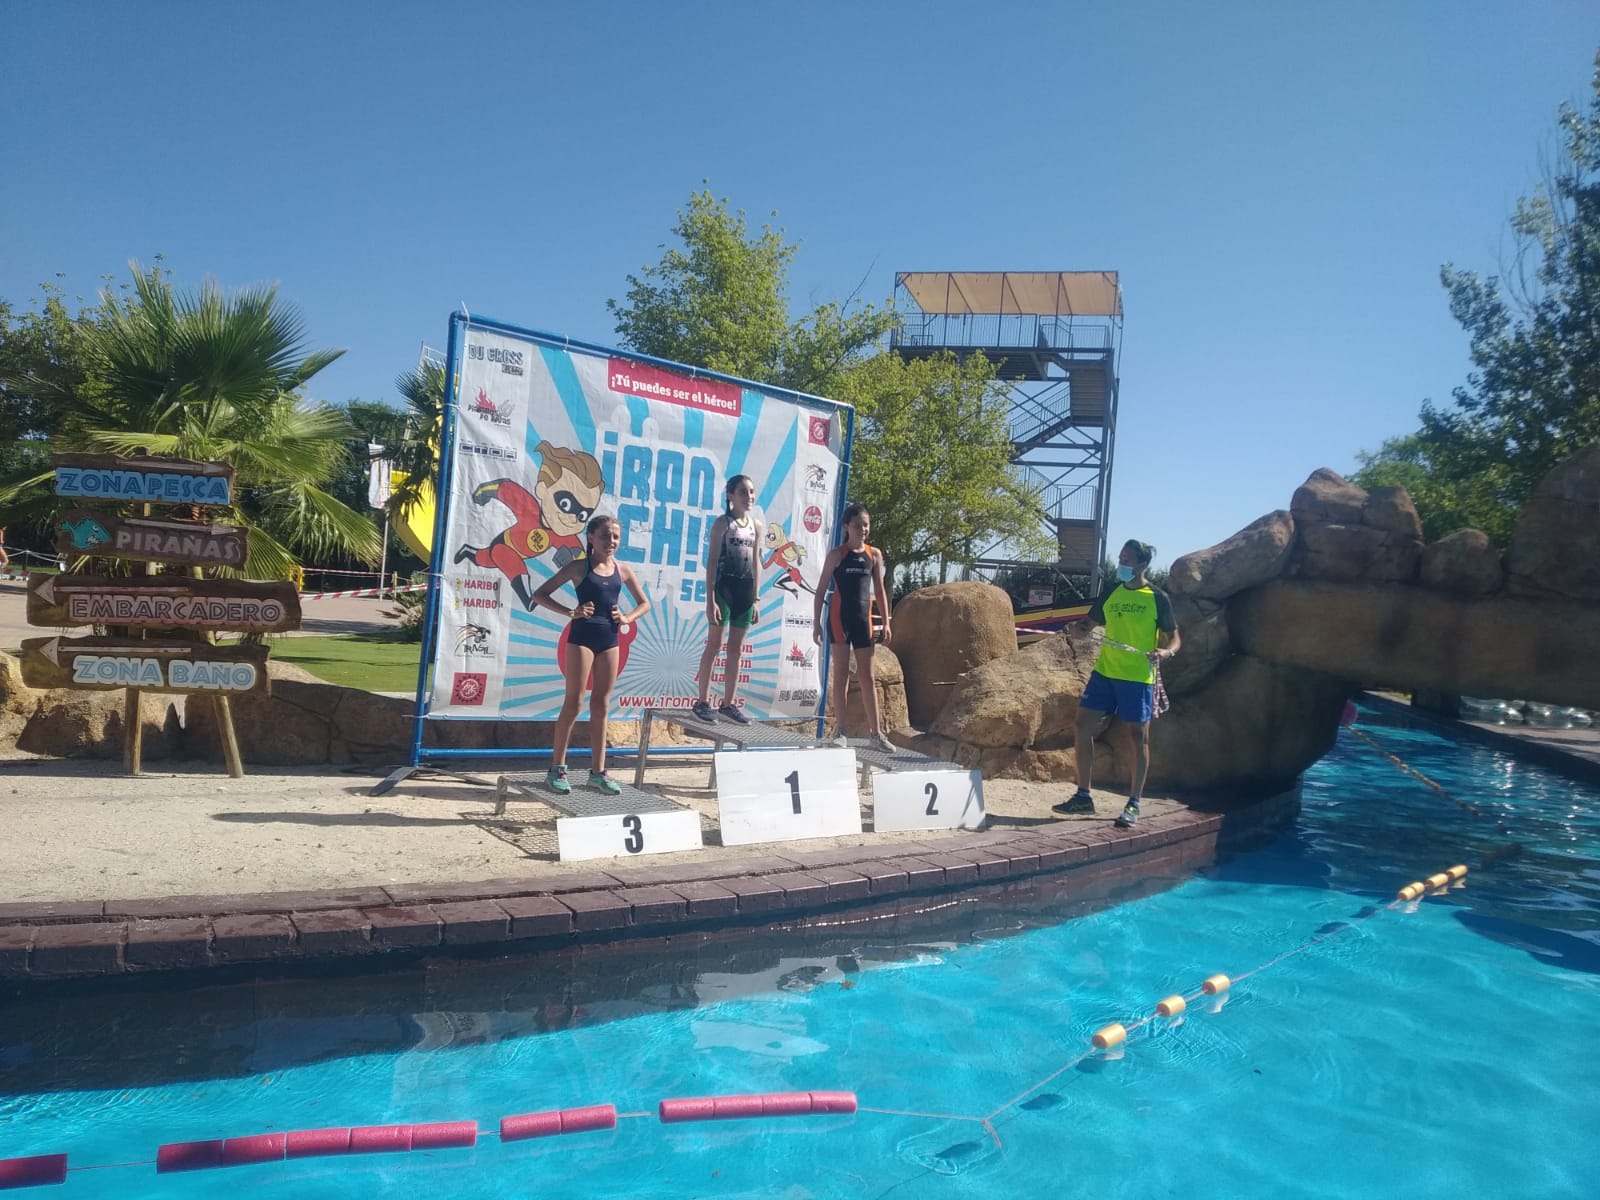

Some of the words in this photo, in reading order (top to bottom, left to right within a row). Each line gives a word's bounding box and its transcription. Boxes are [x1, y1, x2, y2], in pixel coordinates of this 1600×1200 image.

[487, 348, 524, 366] CROSS
[611, 373, 631, 388] ¡Tú
[632, 380, 671, 397] puedes
[673, 389, 690, 400] ser
[691, 391, 702, 403] el
[704, 393, 737, 410] héroe!
[59, 471, 143, 496] ZONA
[146, 476, 227, 500] PESCA
[115, 530, 239, 560] PIRAÑAS
[464, 579, 499, 591] HARIBO
[71, 598, 281, 623] EMBARCADERO
[463, 598, 498, 609] HARIBO
[76, 659, 161, 683] ZONA
[171, 664, 255, 688] BAÑO
[784, 770, 802, 815] 1
[924, 782, 940, 816] 2
[622, 814, 644, 854] 3
